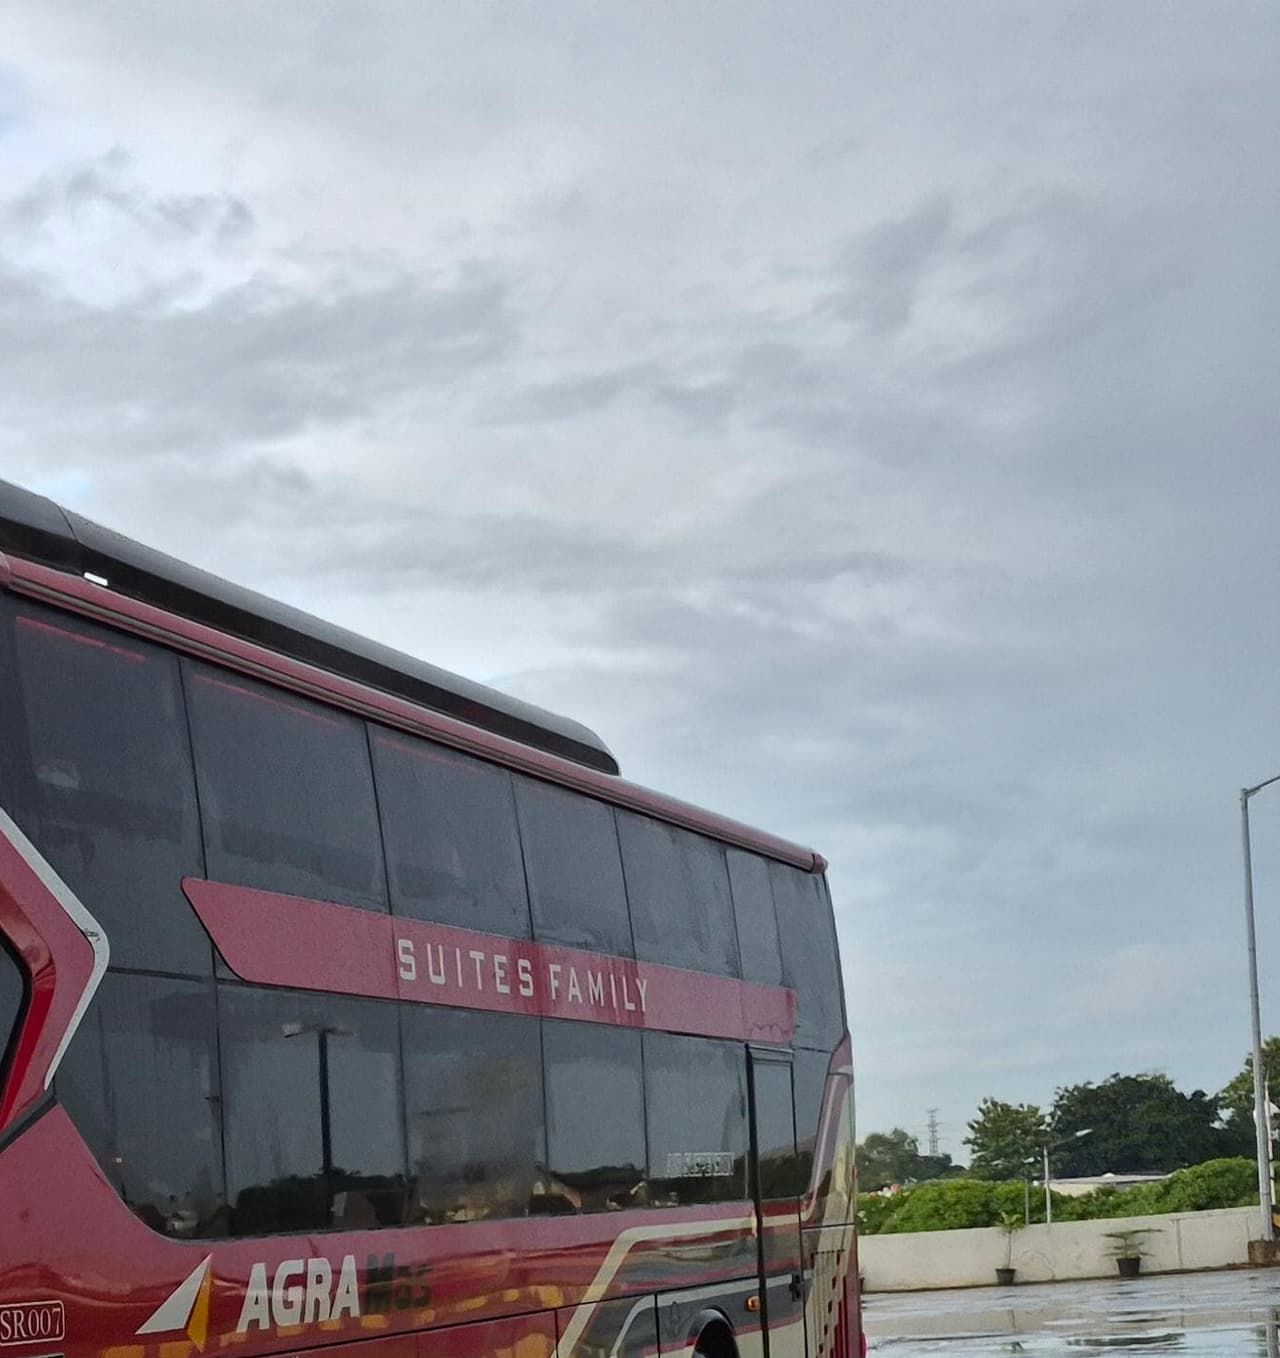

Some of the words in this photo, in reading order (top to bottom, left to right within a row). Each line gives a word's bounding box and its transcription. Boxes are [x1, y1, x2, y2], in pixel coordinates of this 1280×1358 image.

[397, 938, 535, 997] SUITES
[548, 963, 648, 1013] FAMILY
[0, 1307, 61, 1341] SR007
[236, 1254, 361, 1334] AGRA
